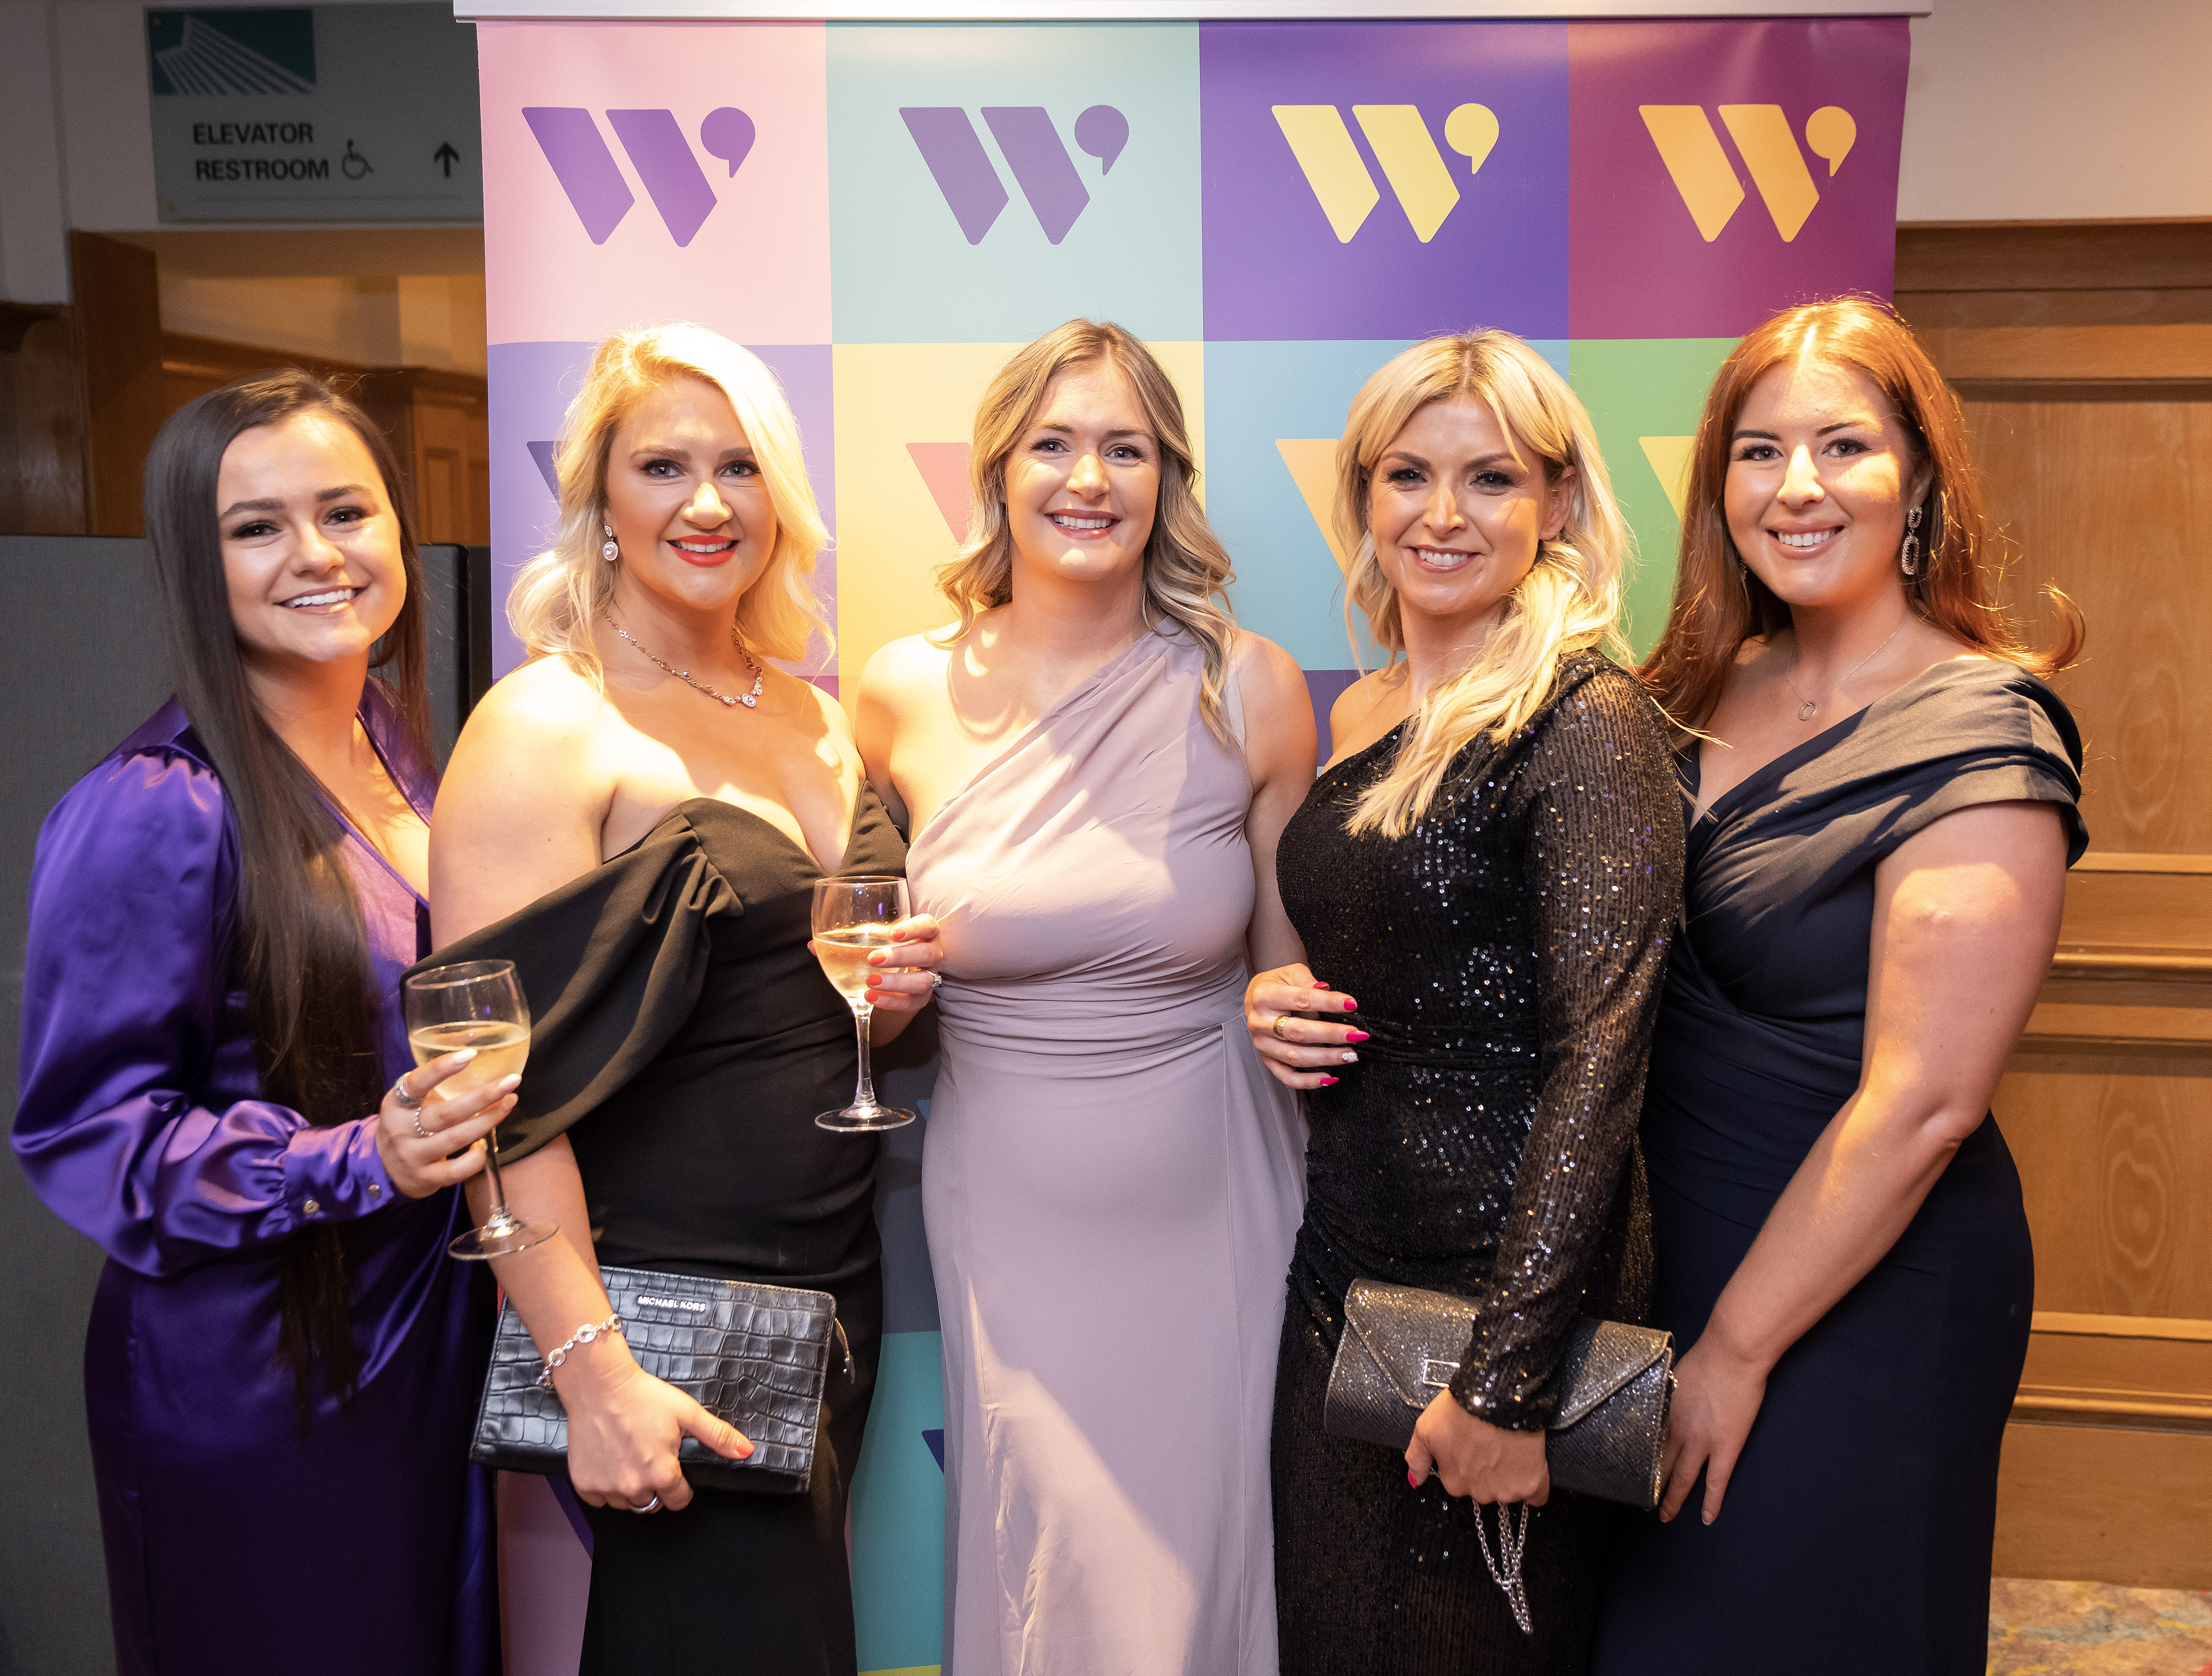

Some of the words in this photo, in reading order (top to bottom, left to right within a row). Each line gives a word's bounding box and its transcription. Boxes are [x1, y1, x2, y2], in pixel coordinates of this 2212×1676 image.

[193, 122, 313, 145] ELEVATOR
[196, 158, 329, 181] RESTROOM
[637, 1296, 679, 1309] MICHAEL
[680, 1300, 706, 1312] KORS
